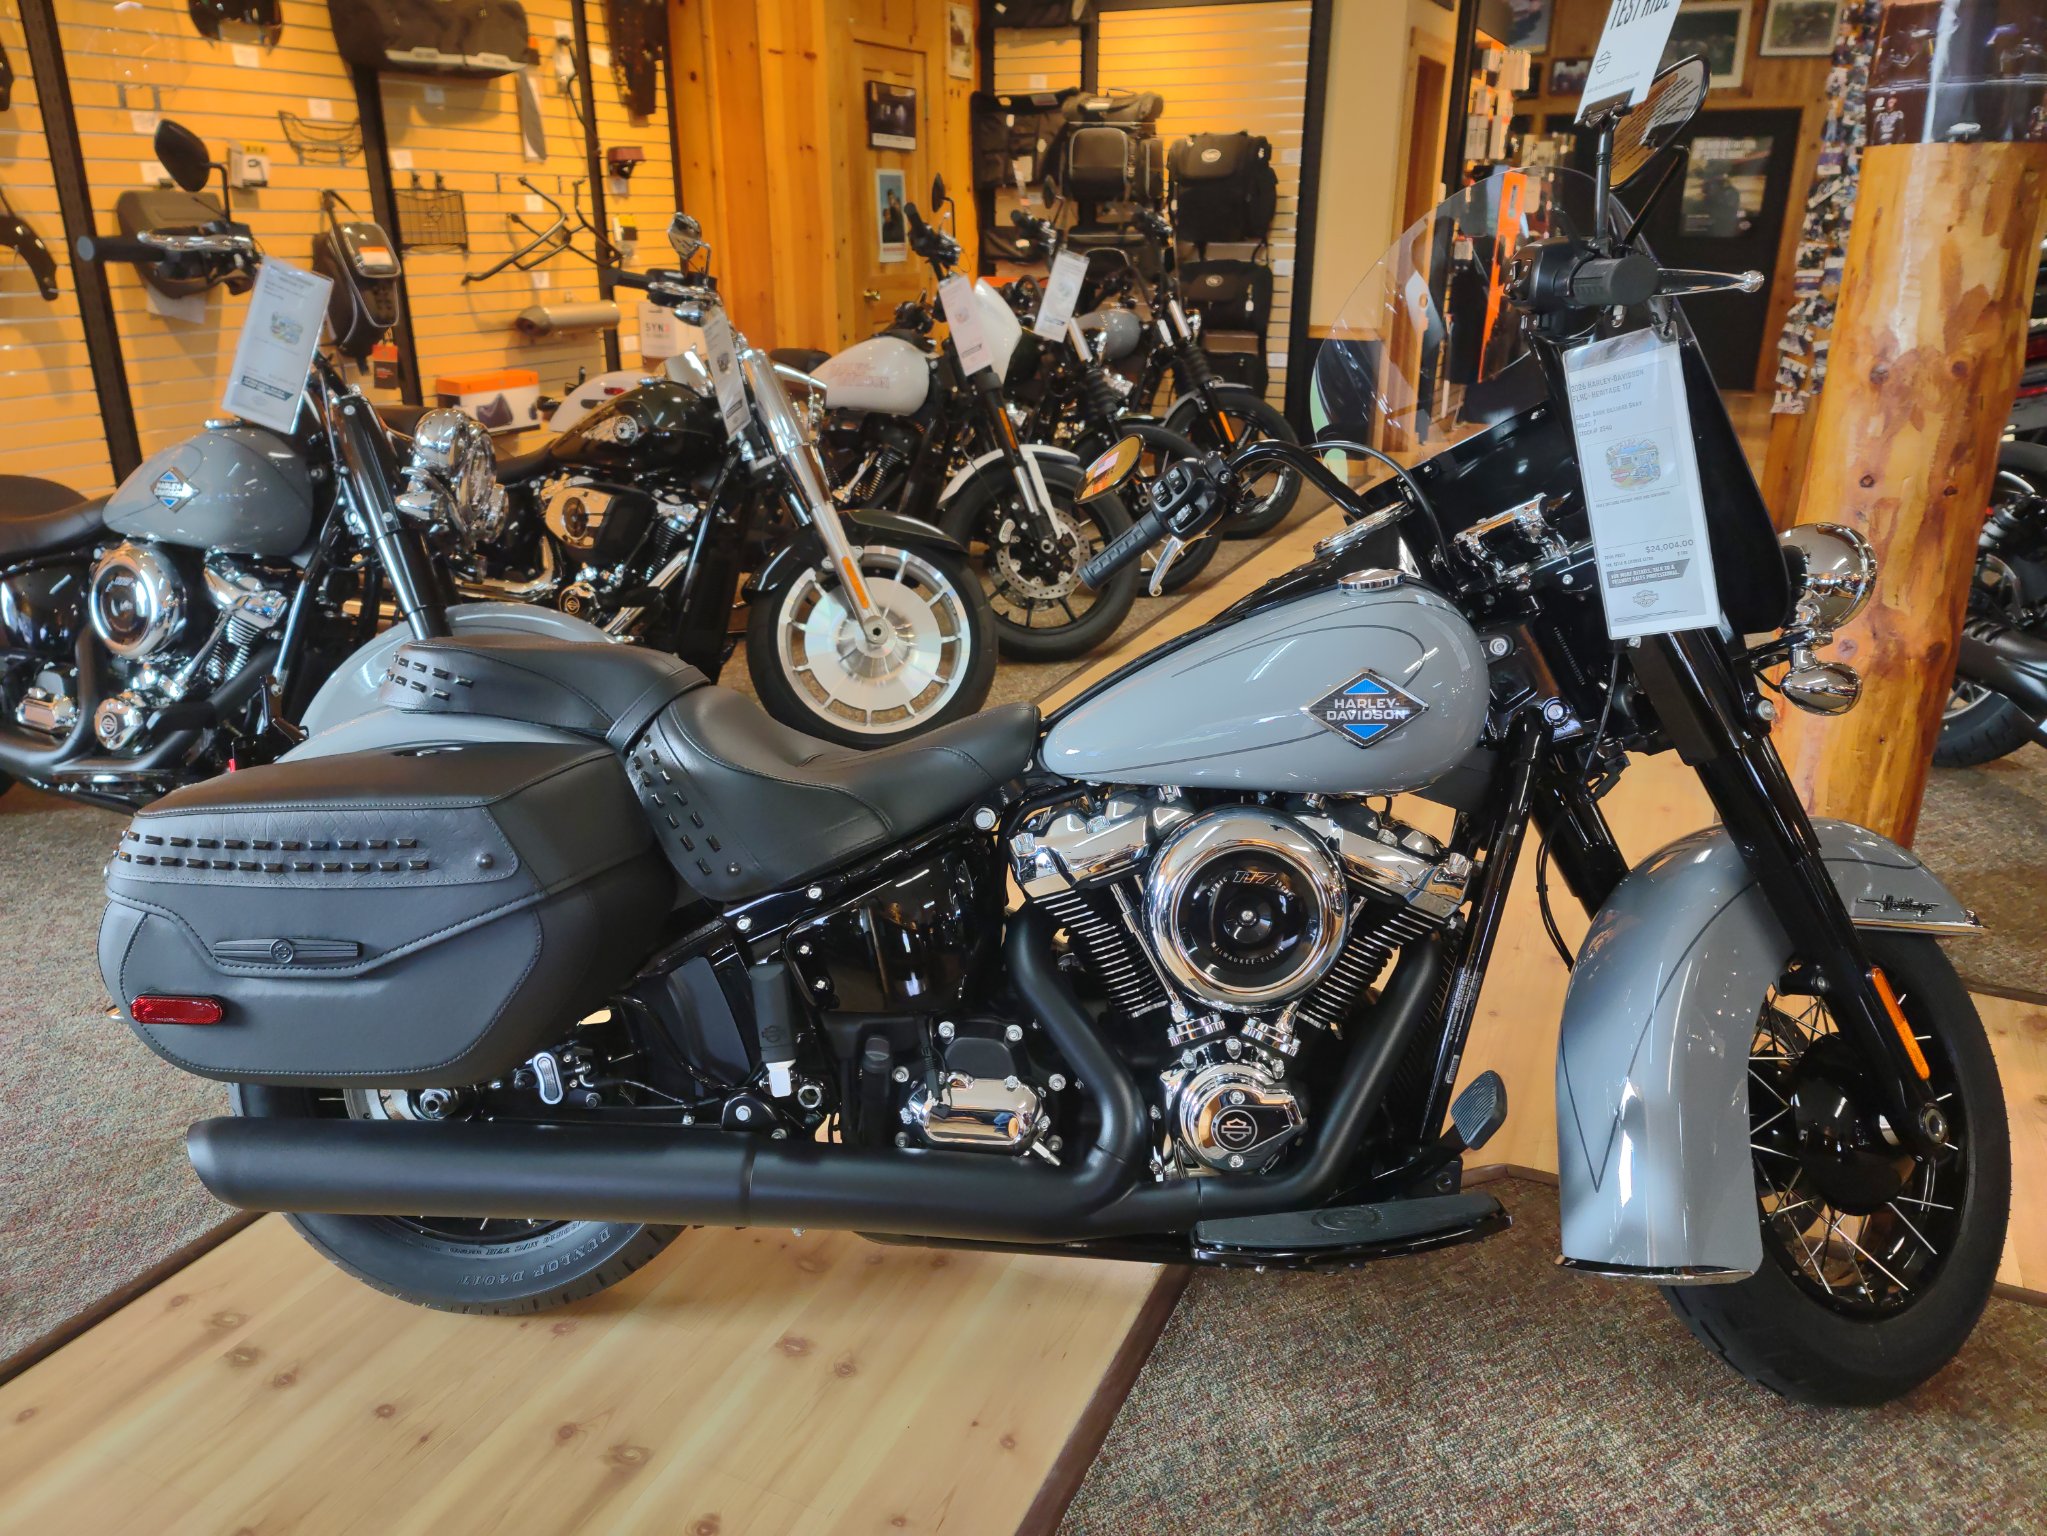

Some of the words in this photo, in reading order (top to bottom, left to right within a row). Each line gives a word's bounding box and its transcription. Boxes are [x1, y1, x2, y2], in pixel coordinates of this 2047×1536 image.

[1646, 539, 1694, 554] $24,004.00
[1334, 698, 1400, 709] HARLEY-
[1326, 709, 1406, 720] DAVIDSON
[533, 1226, 612, 1278] DUNLOP
